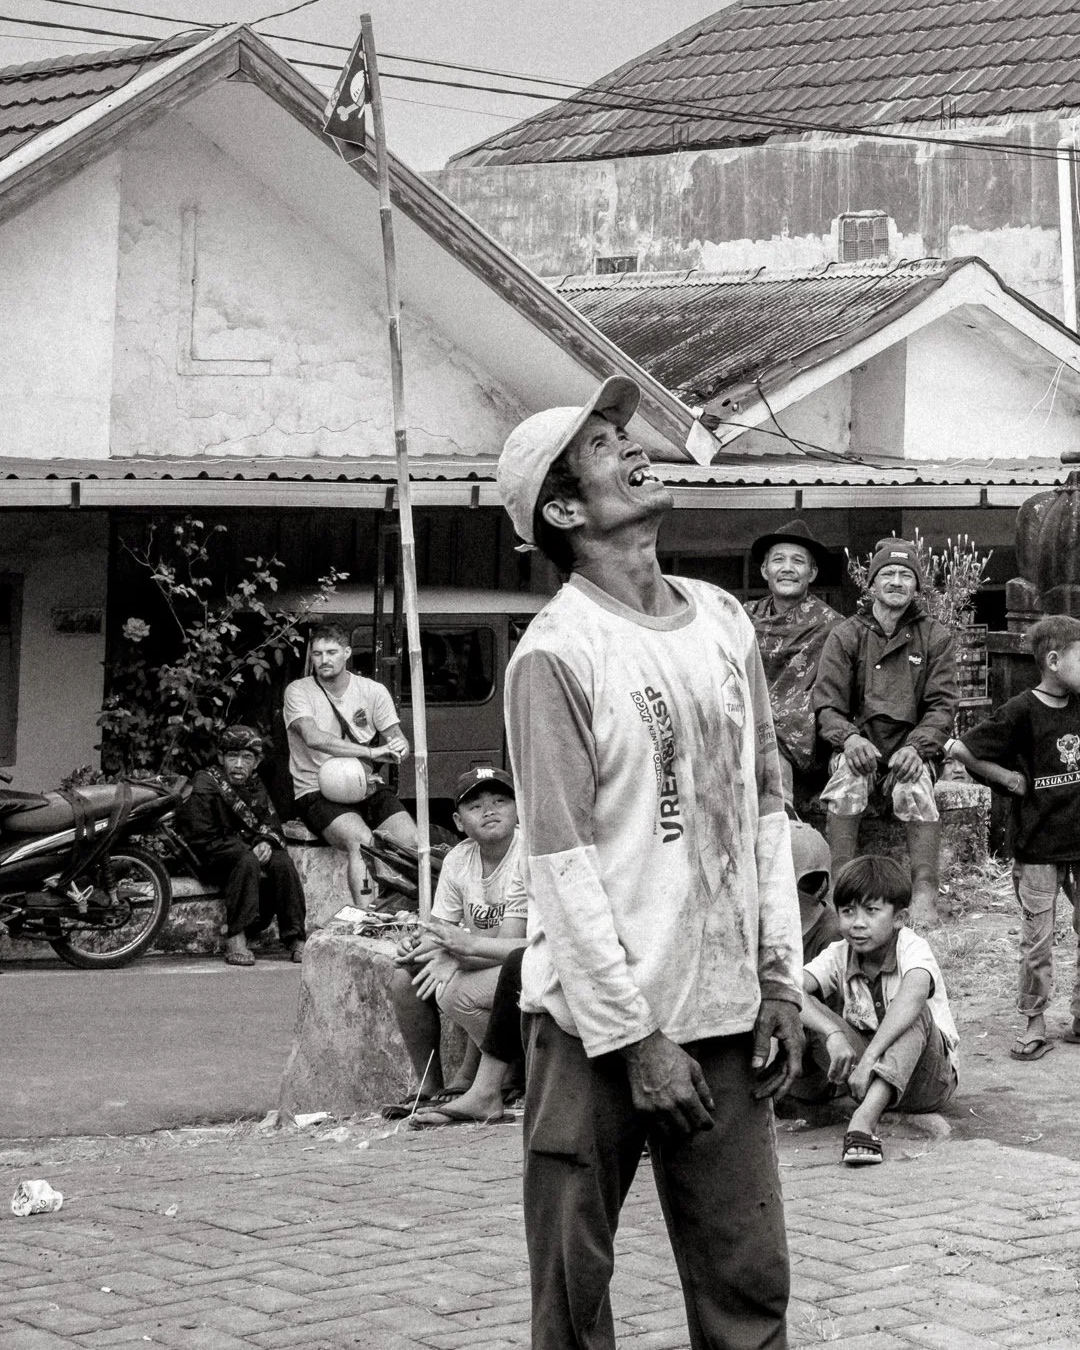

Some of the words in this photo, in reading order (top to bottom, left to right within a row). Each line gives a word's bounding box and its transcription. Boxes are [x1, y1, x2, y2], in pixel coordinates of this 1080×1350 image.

[630, 691, 653, 724] JAGO!
[648, 724, 660, 752] PANEN
[1034, 774, 1074, 787] PASUKAN
